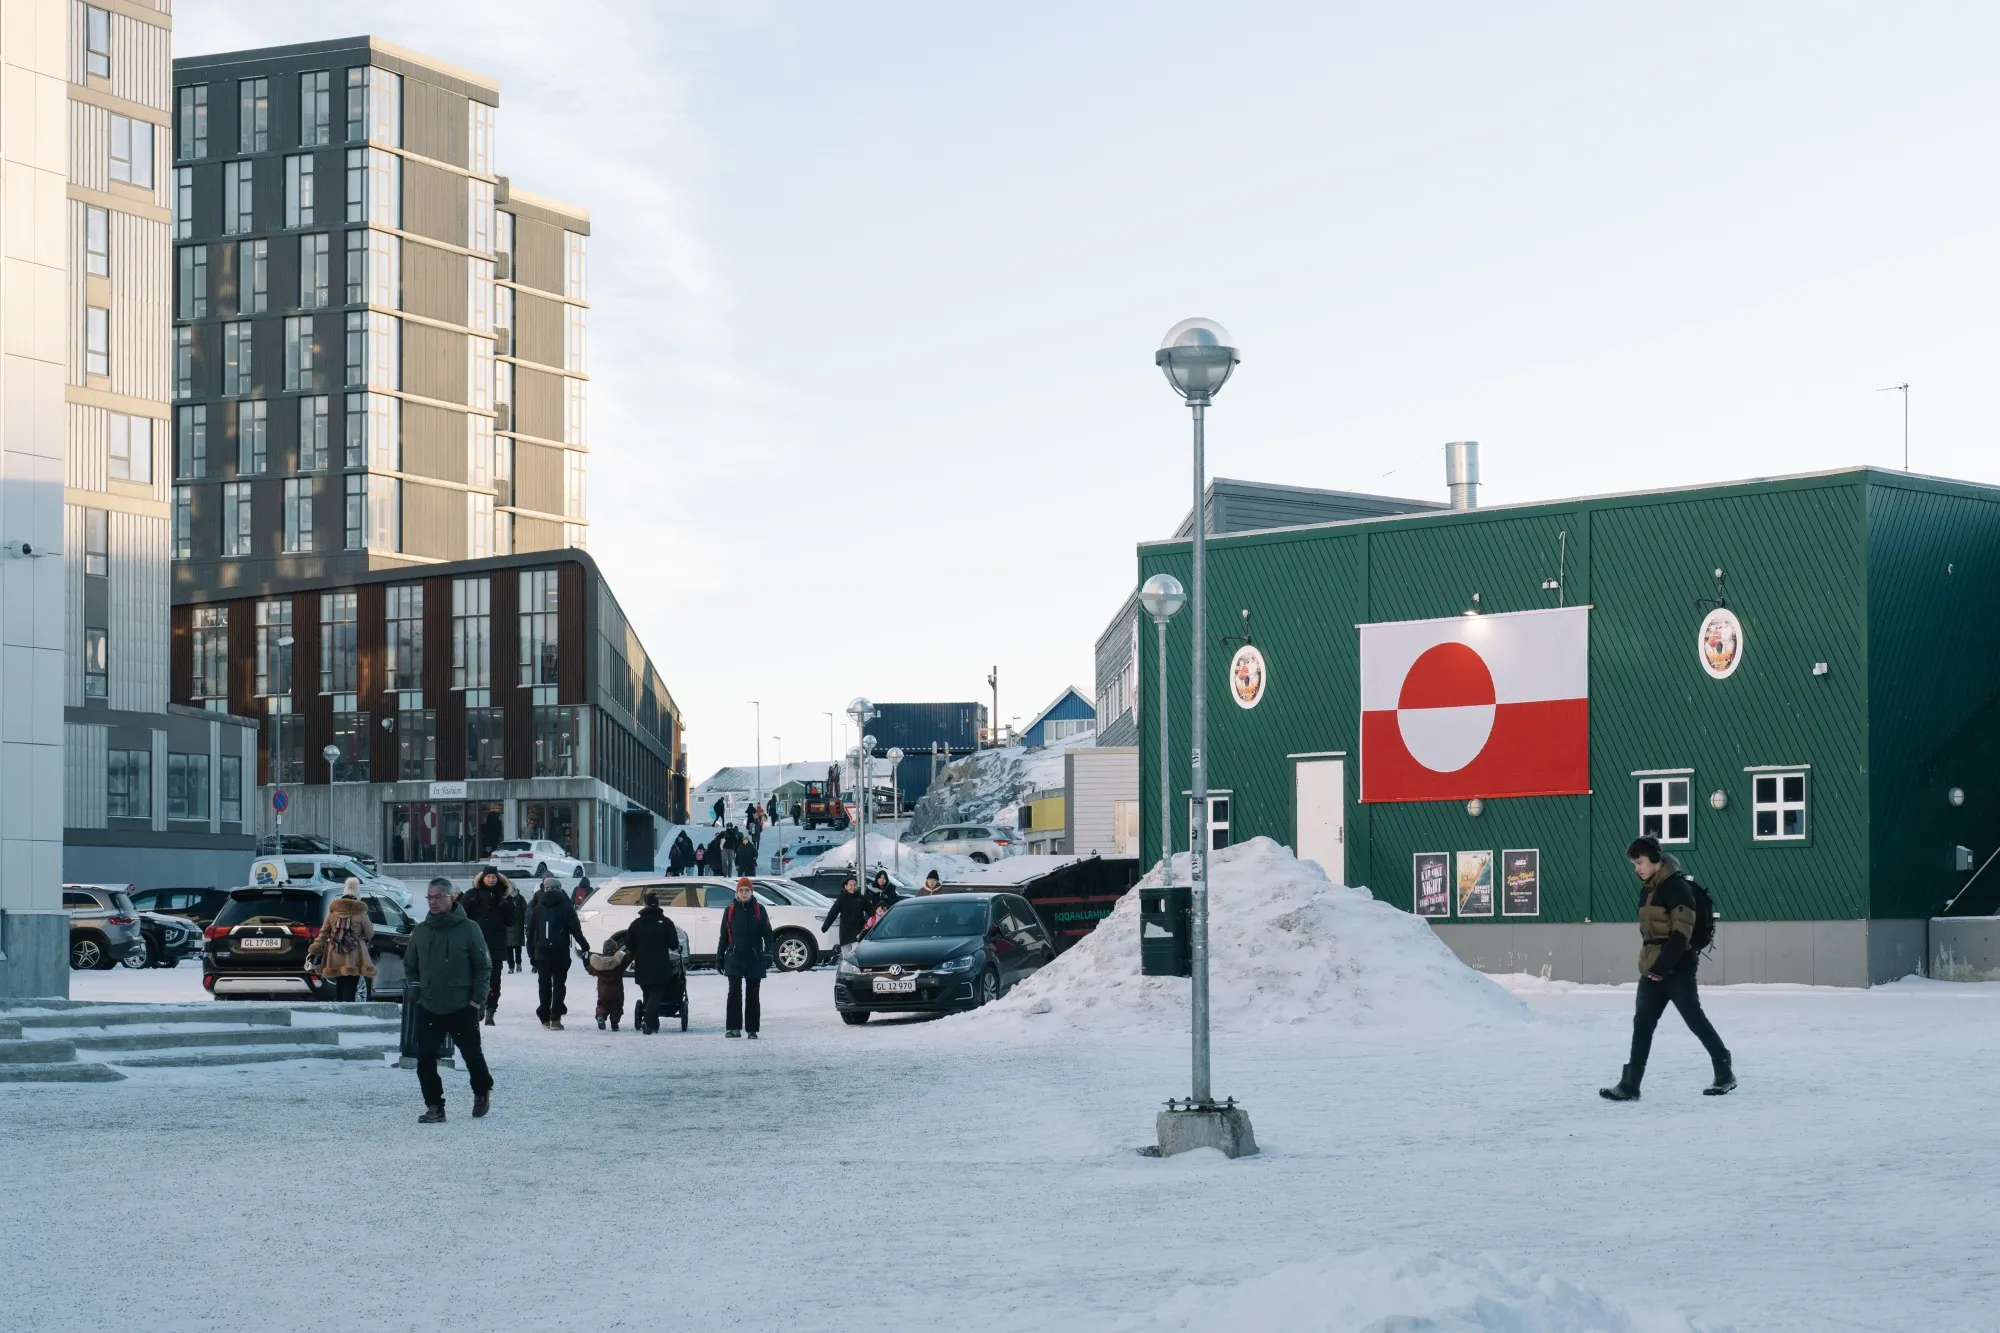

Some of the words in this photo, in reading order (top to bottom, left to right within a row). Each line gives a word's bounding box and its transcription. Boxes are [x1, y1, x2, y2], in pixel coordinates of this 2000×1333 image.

[244, 939, 253, 947] GL
[256, 939, 264, 947] 17
[265, 939, 279, 947] 084
[876, 982, 886, 991] GL
[889, 982, 897, 990] 12
[898, 982, 913, 990] 970
